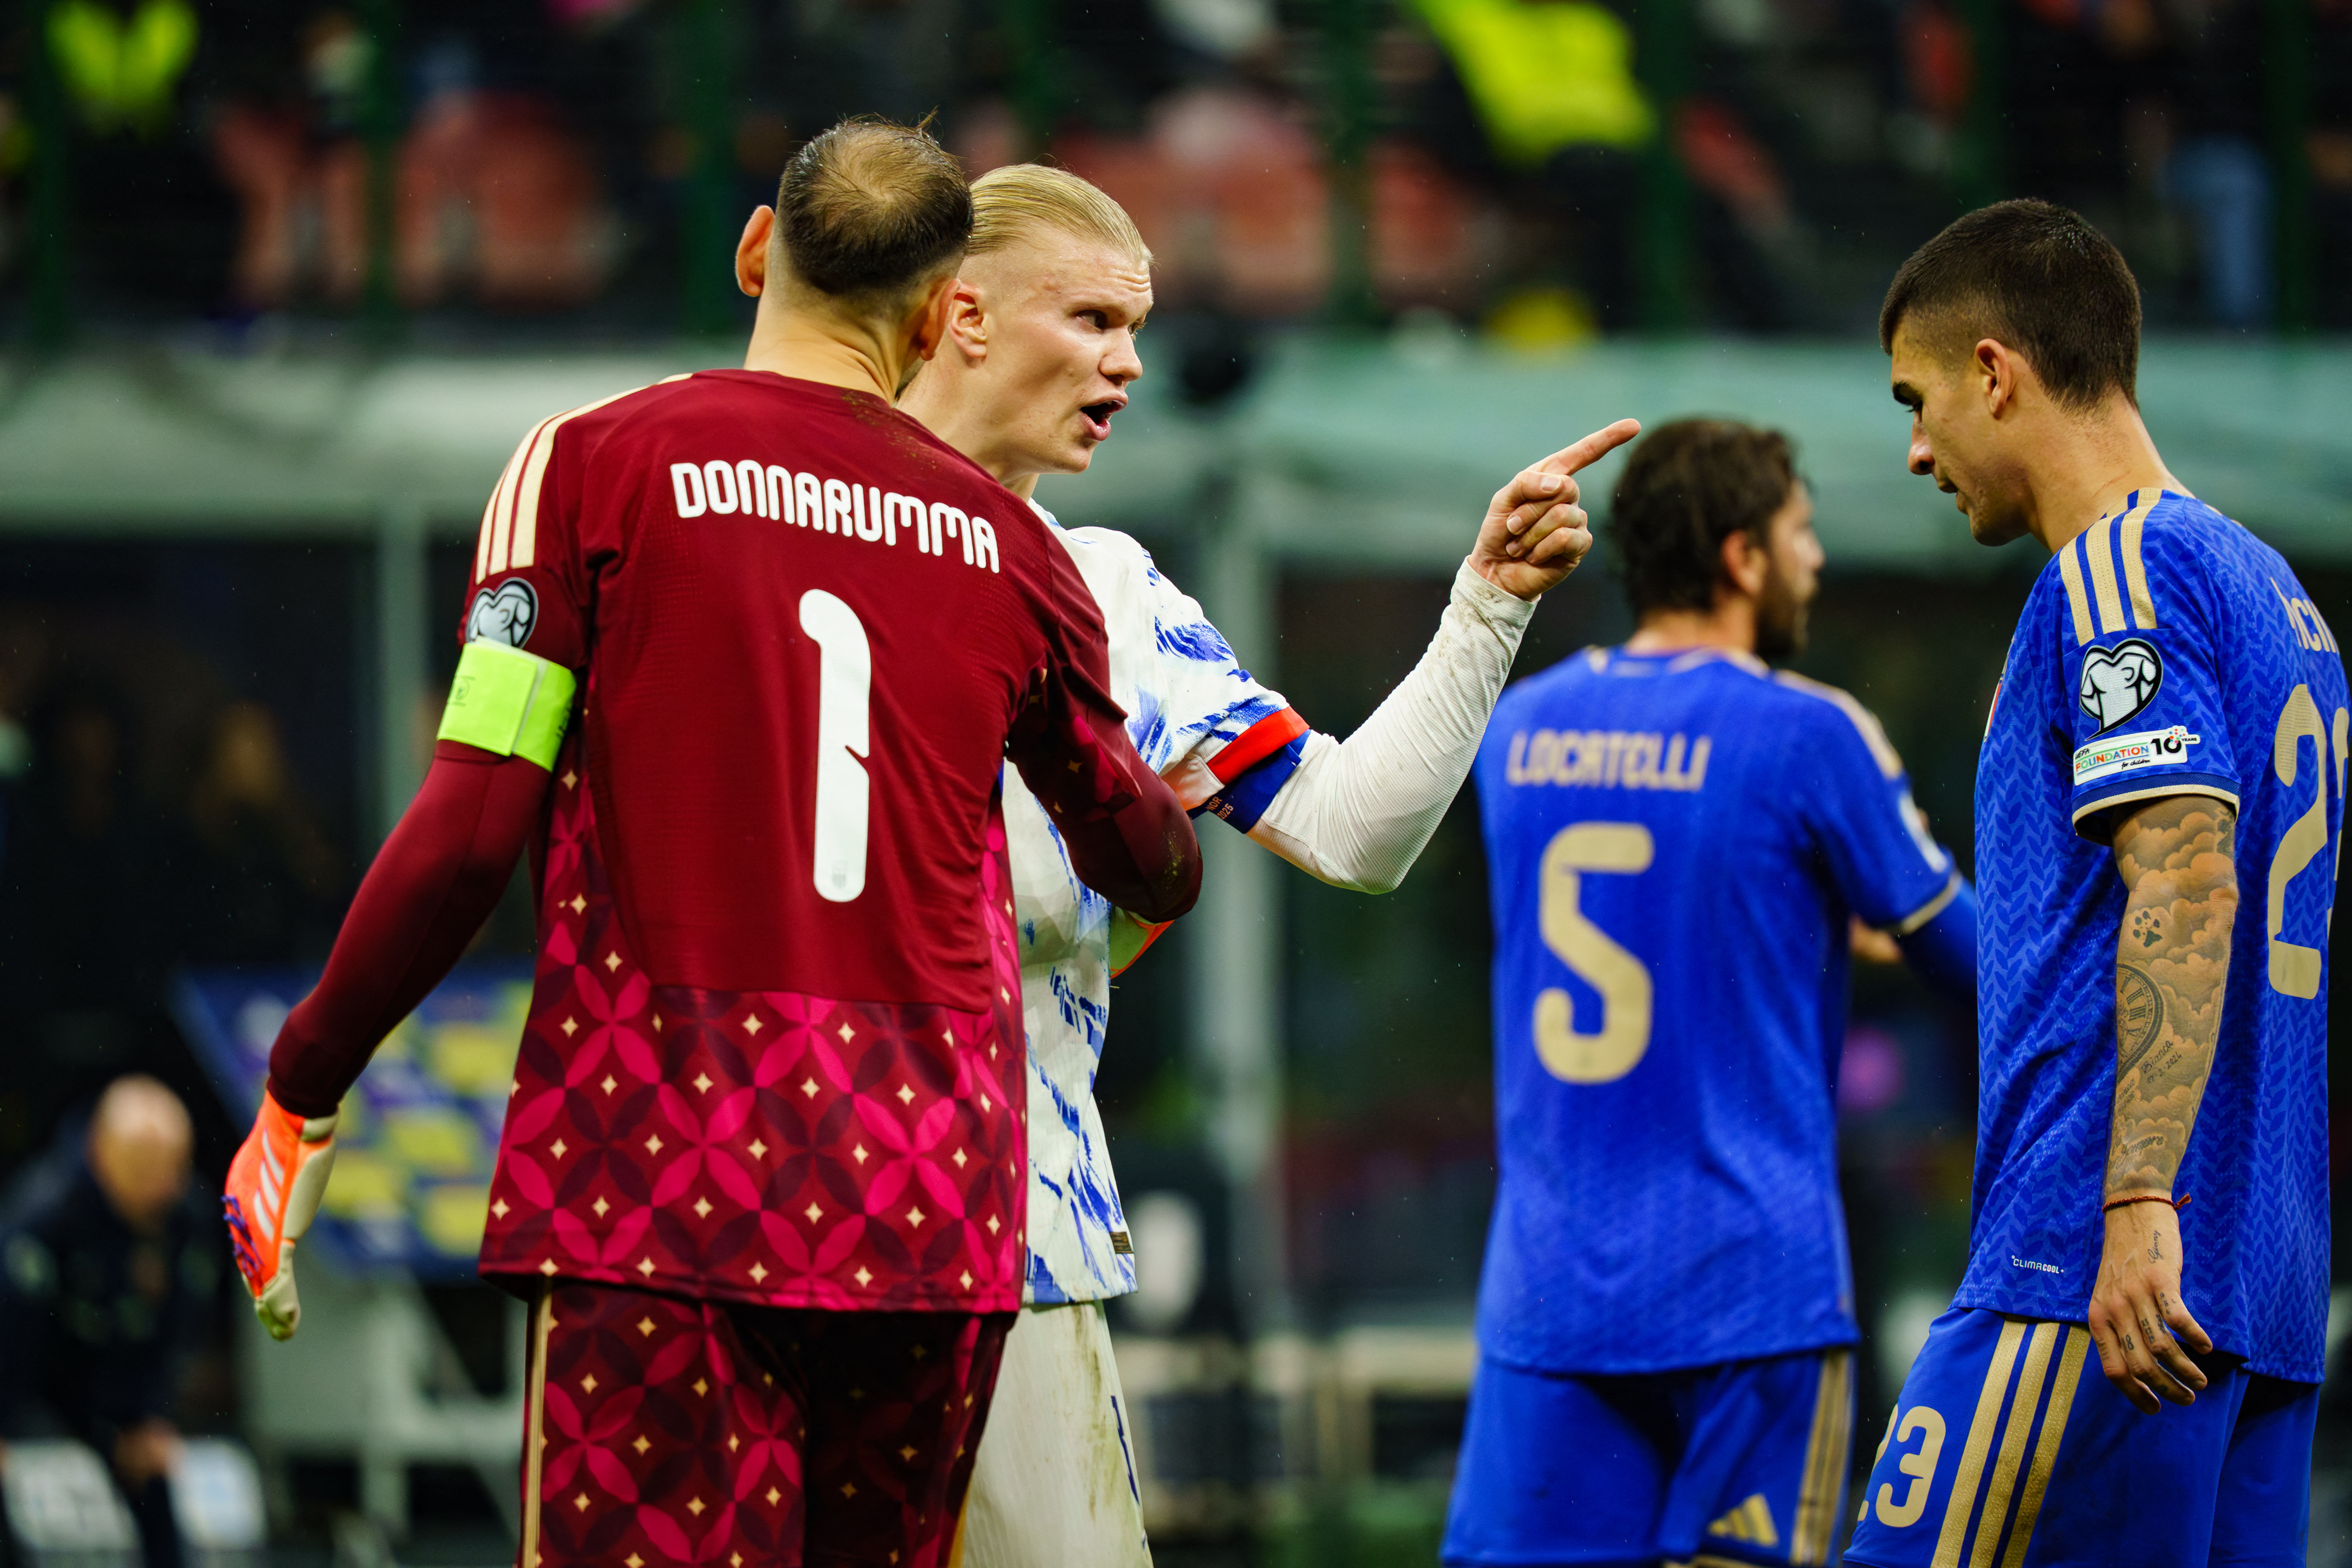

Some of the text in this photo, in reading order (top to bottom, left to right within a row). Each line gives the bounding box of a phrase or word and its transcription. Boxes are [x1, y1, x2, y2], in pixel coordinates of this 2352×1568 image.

[670, 460, 999, 573] DONNARUMMA
[799, 589, 871, 903] 1
[1505, 729, 1712, 792] LOCATELLI
[2075, 747, 2090, 759] UEFA
[2076, 745, 2150, 773] FOUNDATION
[2150, 736, 2182, 755] 10
[1533, 822, 1655, 1085] 5
